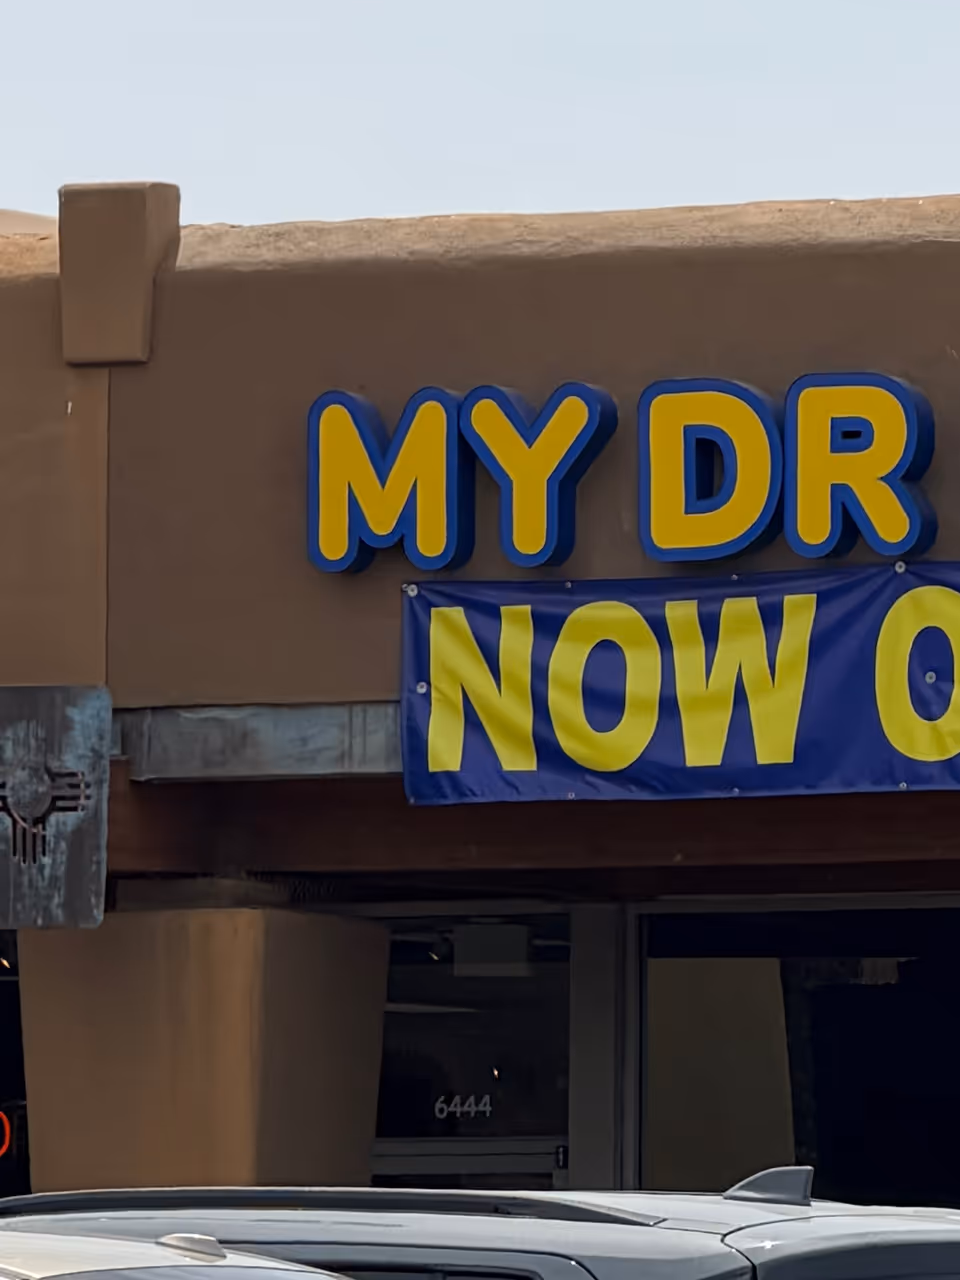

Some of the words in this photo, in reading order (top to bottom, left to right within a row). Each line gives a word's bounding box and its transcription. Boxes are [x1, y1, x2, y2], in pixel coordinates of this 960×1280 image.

[308, 381, 616, 573] MY
[638, 373, 936, 562] DR
[427, 593, 817, 772] NOW
[433, 1094, 493, 1119] 6444
